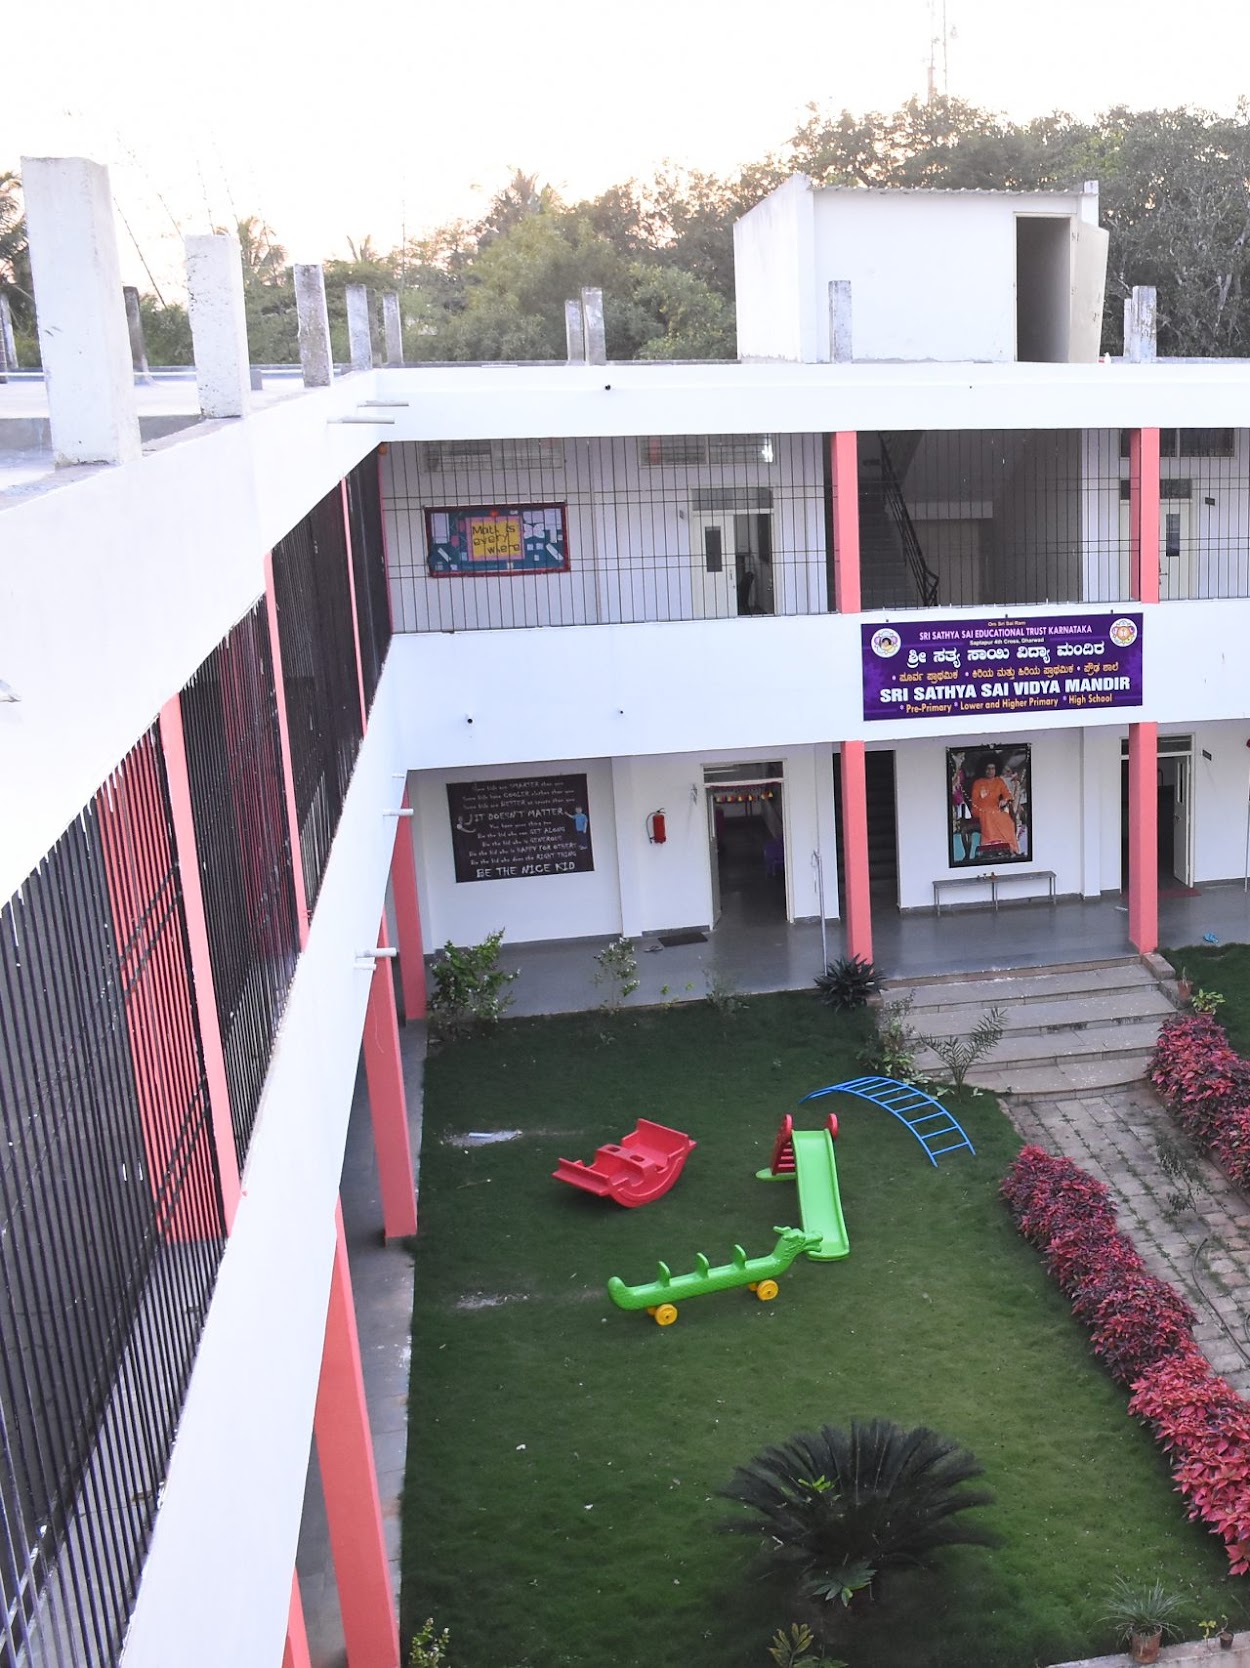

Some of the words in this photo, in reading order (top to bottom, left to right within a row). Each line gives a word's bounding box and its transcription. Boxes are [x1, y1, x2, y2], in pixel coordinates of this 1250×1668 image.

[920, 632, 930, 640] SRI
[932, 631, 960, 640] SATHYA
[962, 630, 973, 638] SAI
[975, 628, 1024, 638] EDUCATIONAL
[1026, 627, 1047, 636] TRUST
[1048, 625, 1092, 634] KARNATAKA
[907, 649, 926, 668] ಶ್ರೀ
[933, 647, 960, 668] ಸತ್ಯ
[967, 648, 1010, 661] ಸಾಯಿ
[1016, 646, 1050, 664] ವಿದ್ಯಾ
[1057, 640, 1105, 656] ಮಂದಿರ
[880, 688, 908, 703] SRI
[914, 685, 977, 701] SATHYA
[981, 683, 1008, 697] SAI
[1013, 680, 1060, 696] VIDYA
[1065, 677, 1130, 693] MANDIR
[906, 703, 952, 713] Pre-Primary
[961, 702, 984, 710] Lower
[986, 700, 1000, 708] and
[1002, 698, 1027, 709] Higher
[1029, 696, 1058, 707] Primary
[1069, 695, 1086, 706] High
[1089, 693, 1112, 703] School
[474, 814, 485, 822] IT
[488, 810, 523, 820] DOESN'T
[527, 808, 564, 817] MATTER
[476, 868, 492, 878] BE
[496, 866, 517, 876] THE
[522, 864, 551, 874] NICE
[555, 862, 575, 872] KID
